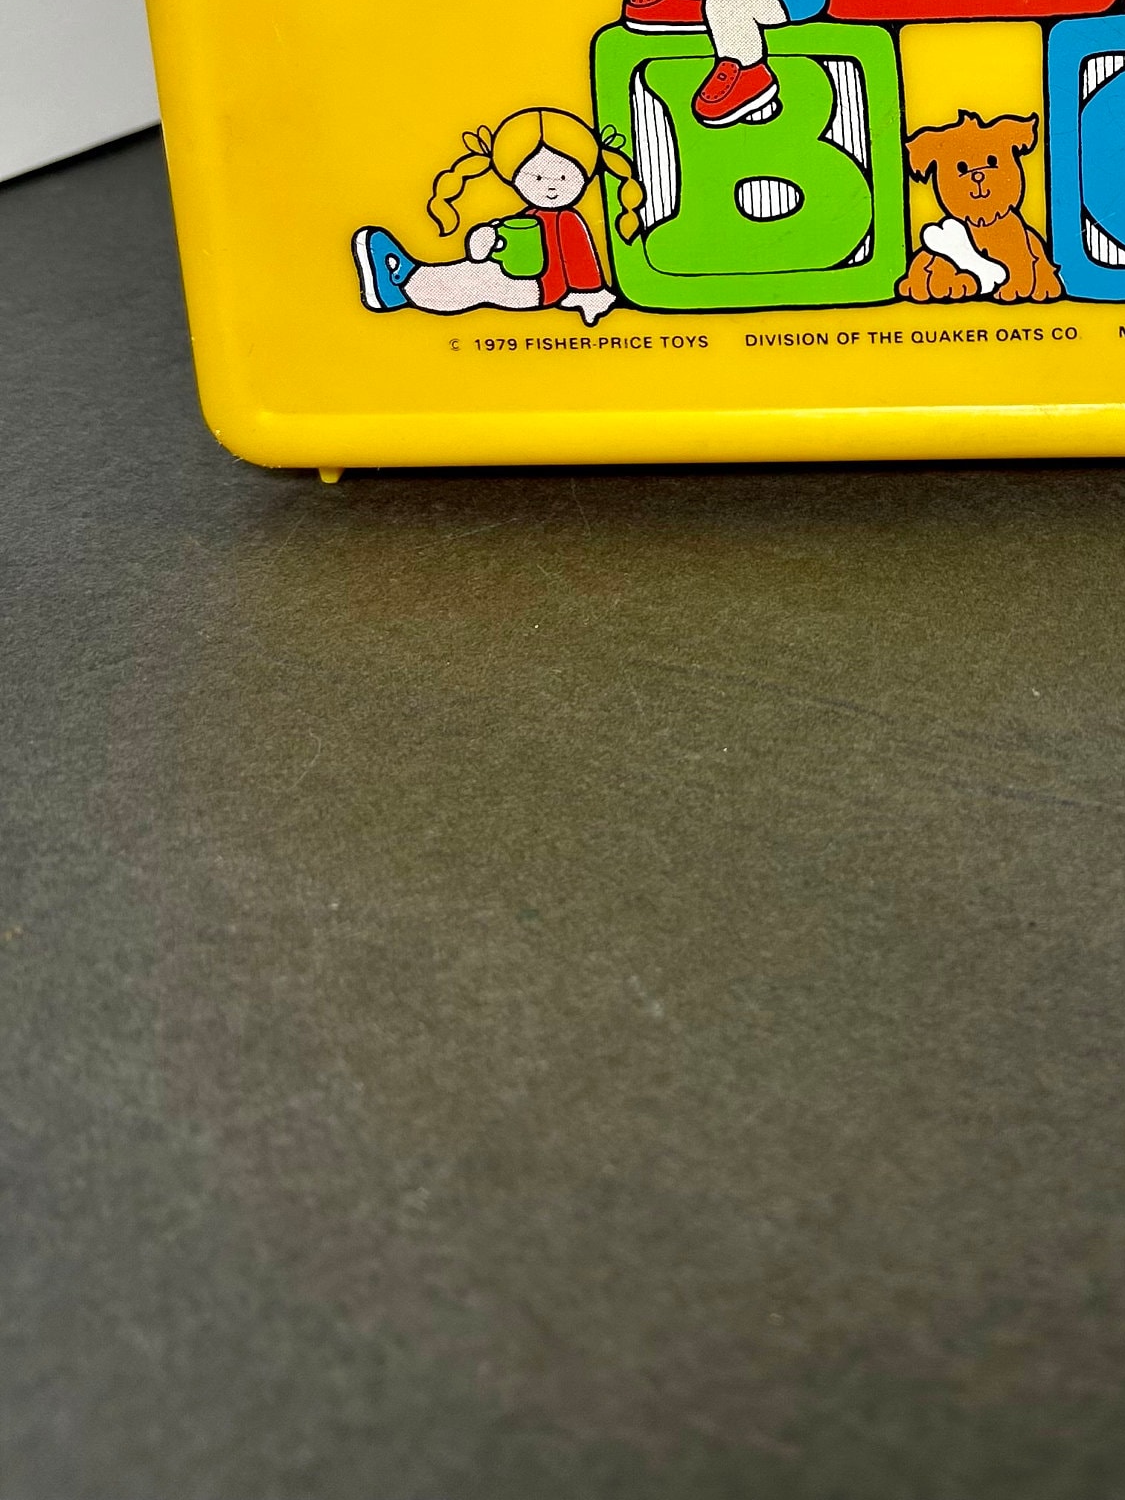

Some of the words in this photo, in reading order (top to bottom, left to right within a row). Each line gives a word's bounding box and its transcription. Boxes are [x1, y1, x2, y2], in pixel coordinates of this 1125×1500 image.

[641, 54, 875, 276] B
[474, 337, 518, 352] 1979
[525, 335, 654, 351] FISHER-PRICE
[660, 334, 710, 349] TOYS
[744, 332, 829, 347] DIVISION
[836, 331, 861, 346] OF
[867, 330, 904, 345] THE
[910, 328, 989, 345] QUAKER
[995, 327, 1045, 342] OATS
